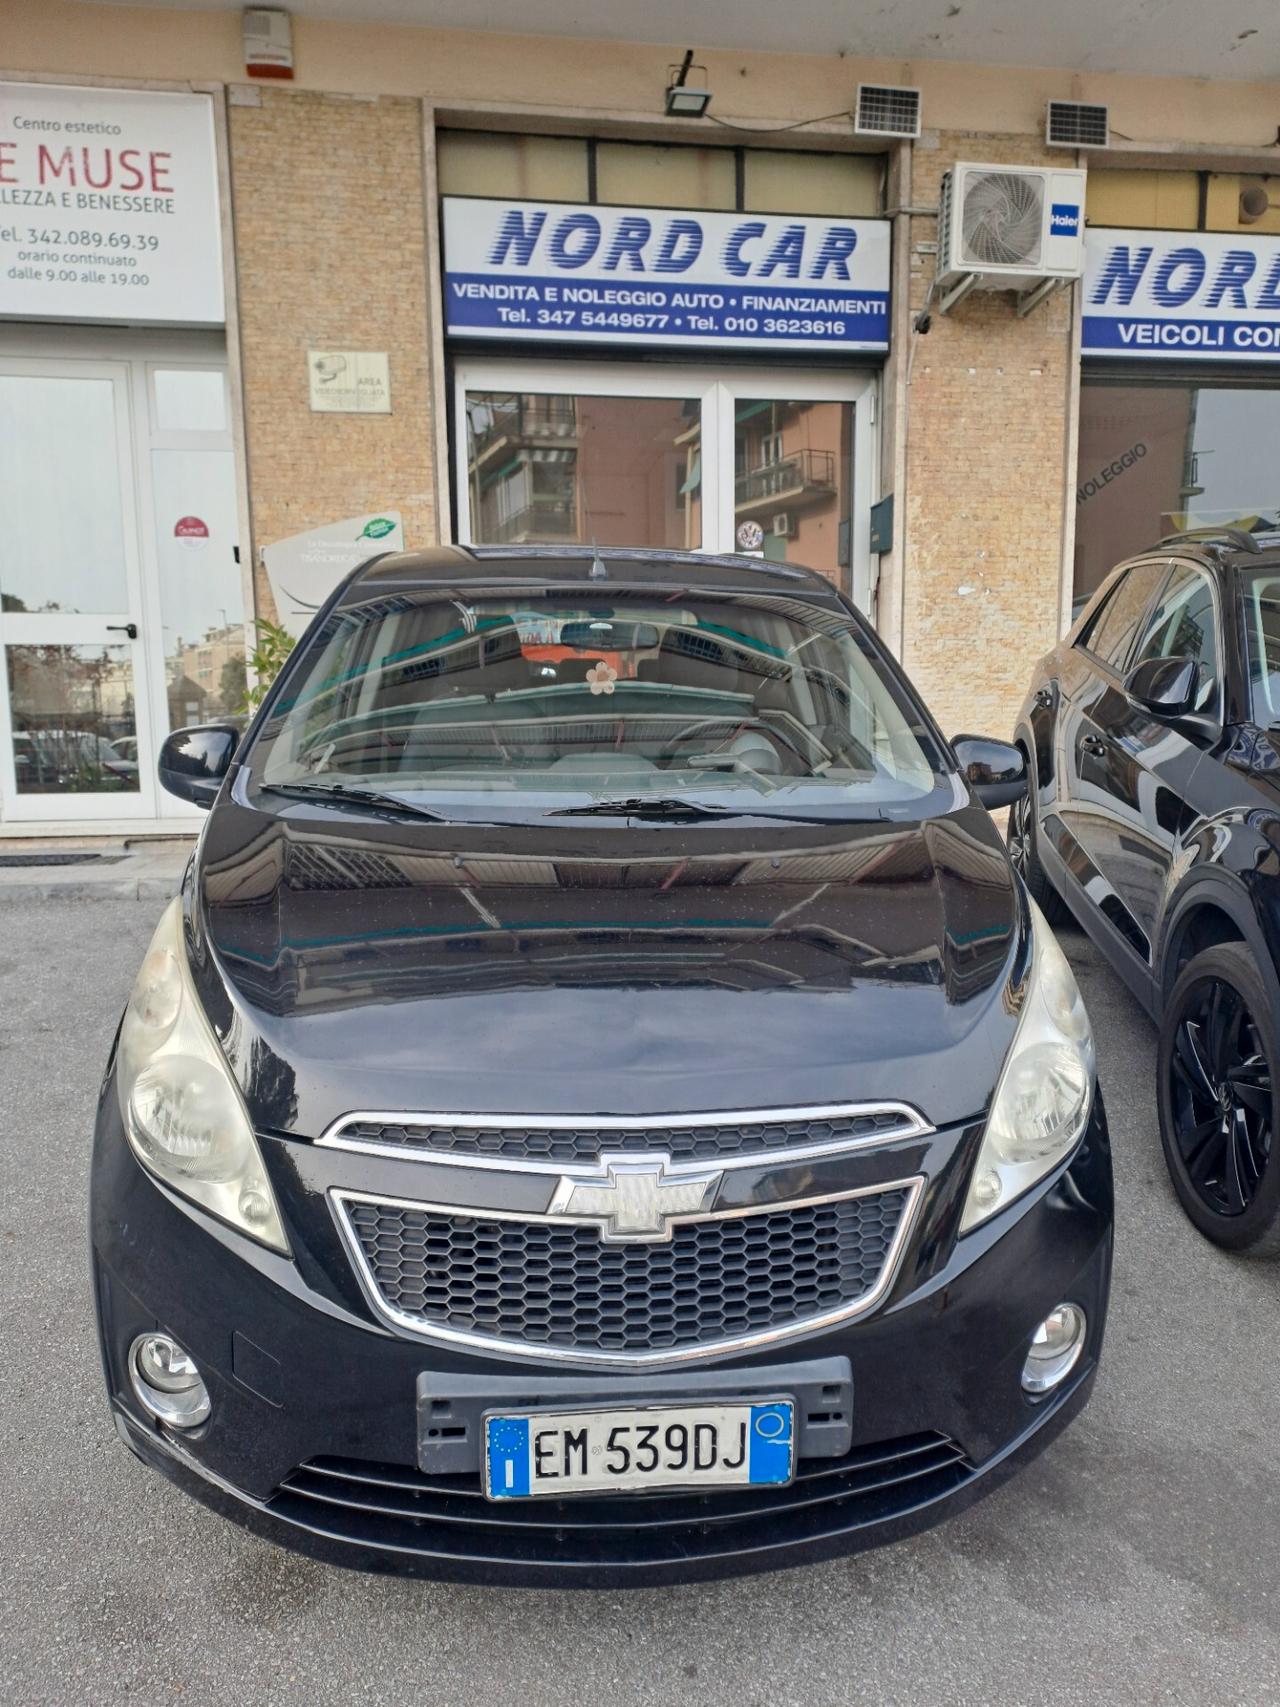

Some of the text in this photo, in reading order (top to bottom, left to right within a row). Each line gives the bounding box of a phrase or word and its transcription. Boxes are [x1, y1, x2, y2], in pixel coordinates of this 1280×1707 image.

[13, 116, 122, 135] Centro estetico
[38, 144, 174, 193] MUSE
[0, 189, 175, 214] LEZZA E BENESSERE
[1051, 214, 1079, 226] Haier
[0, 226, 160, 251] el. 342.089.69.39
[485, 210, 858, 281] NORD CAR
[18, 251, 137, 267] orario continuato
[8, 266, 150, 286] dalle 9.00 alle 19.00
[452, 283, 886, 315] VENDITA E NOLEGGIO AUTO FINANZIAMENTI
[497, 307, 845, 335] Tel. 347 5449677 Tel. 010 3623616
[1118, 323, 1280, 347] VEICOLI CO
[1077, 443, 1147, 505] NOLEGGIO
[535, 1422, 747, 1479] EM 539DJ
